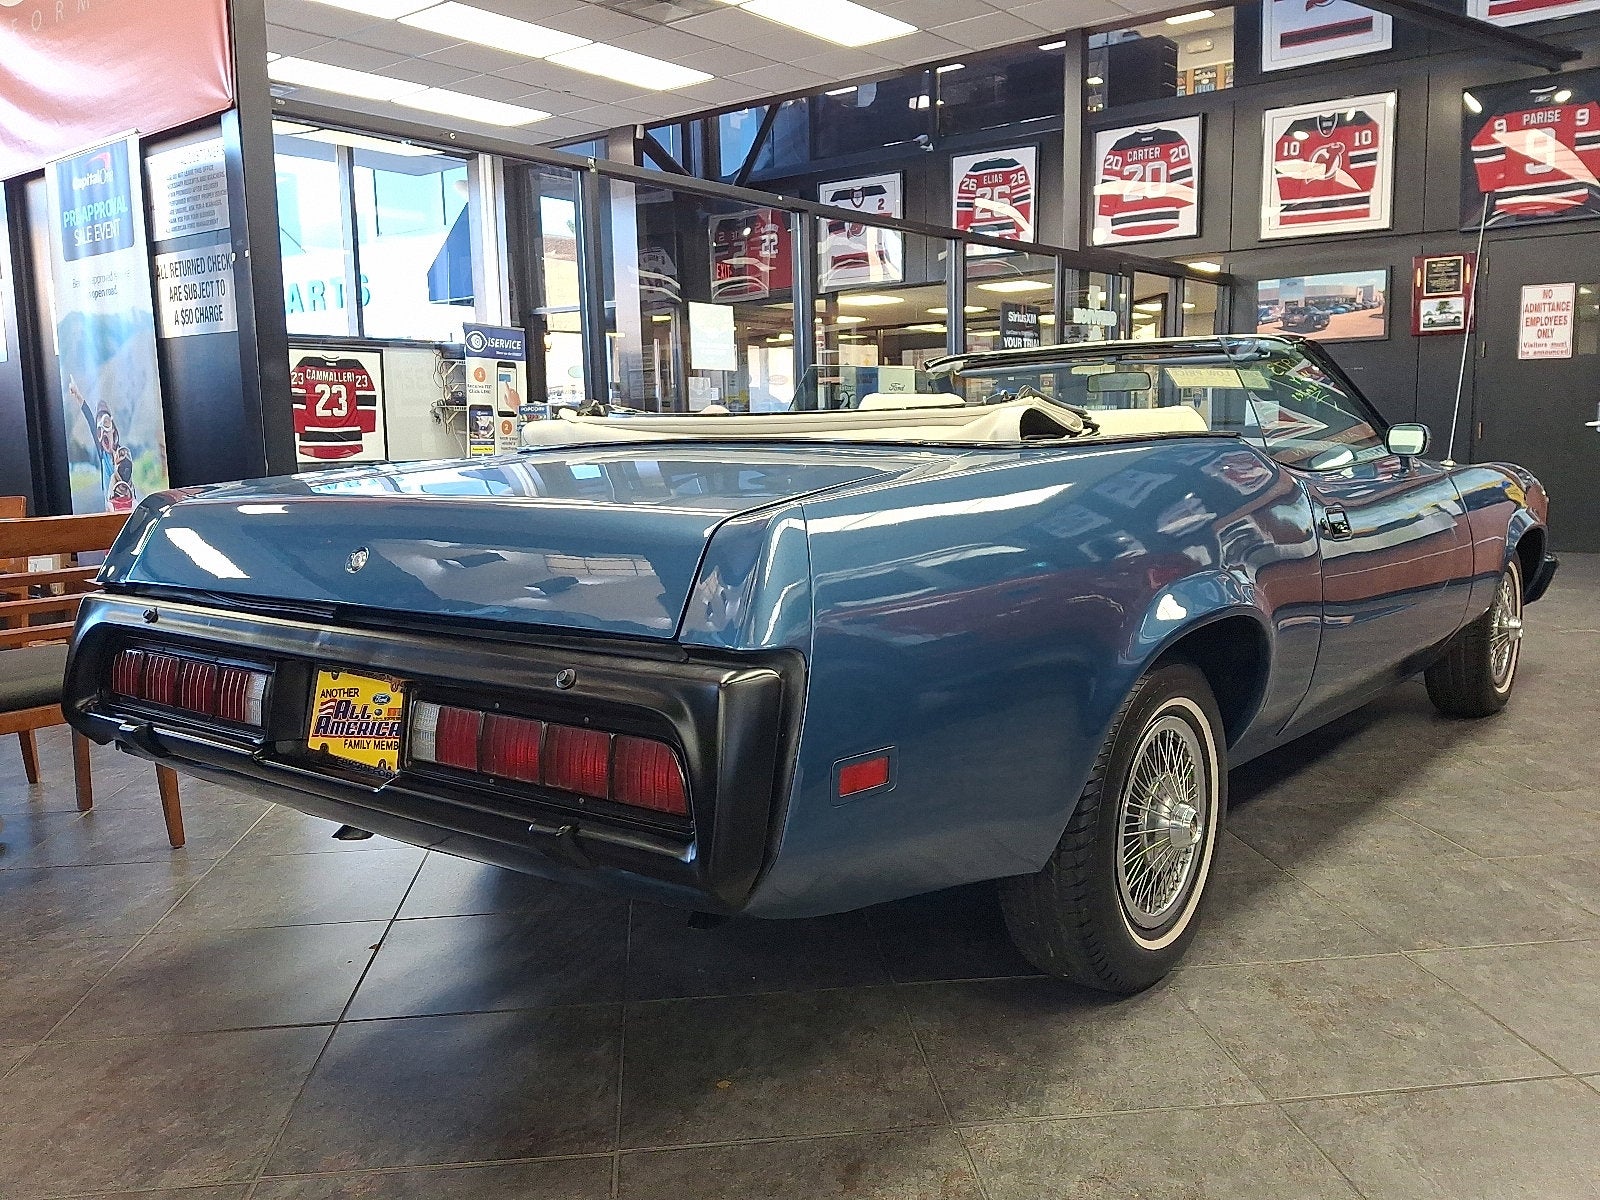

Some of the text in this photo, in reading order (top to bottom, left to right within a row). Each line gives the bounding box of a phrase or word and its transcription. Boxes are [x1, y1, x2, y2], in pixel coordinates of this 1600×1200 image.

[1522, 109, 1561, 126] PARISE
[1575, 107, 1590, 126] 9
[1353, 129, 1372, 147] 10
[1127, 146, 1161, 162] CARTER
[1169, 144, 1189, 163] 20
[1283, 141, 1300, 157] 10
[1524, 127, 1557, 175] 9
[1104, 154, 1122, 170] 20
[962, 177, 977, 191] 26
[983, 173, 1004, 185] ELIAS
[1009, 170, 1026, 186] 26
[1122, 160, 1168, 202] 20
[877, 197, 885, 211] 2
[975, 184, 1012, 219] 26
[156, 253, 232, 281] ALL RETURNED CHECK
[716, 262, 731, 280] EXIT
[169, 278, 226, 302] ARE SUBJECT TO
[286, 273, 371, 314] ARTS
[1542, 288, 1554, 300] NO
[174, 304, 224, 327] A $50 CHARGE
[1524, 301, 1571, 314] ADMITTANCE
[1007, 310, 1037, 325] SiriusXM
[1525, 315, 1568, 328] EMPLOYEES
[1003, 336, 1022, 348] YOUR
[1537, 328, 1555, 340] ONLY
[291, 371, 304, 386] 23
[305, 367, 355, 383] CAMMALLERI
[355, 374, 368, 388] 23
[314, 383, 348, 417] 23
[320, 688, 360, 698] ANOTHER
[333, 699, 373, 720] ALL
[312, 715, 401, 738] AMERICA
[343, 739, 399, 751] FAMILY MEMB
